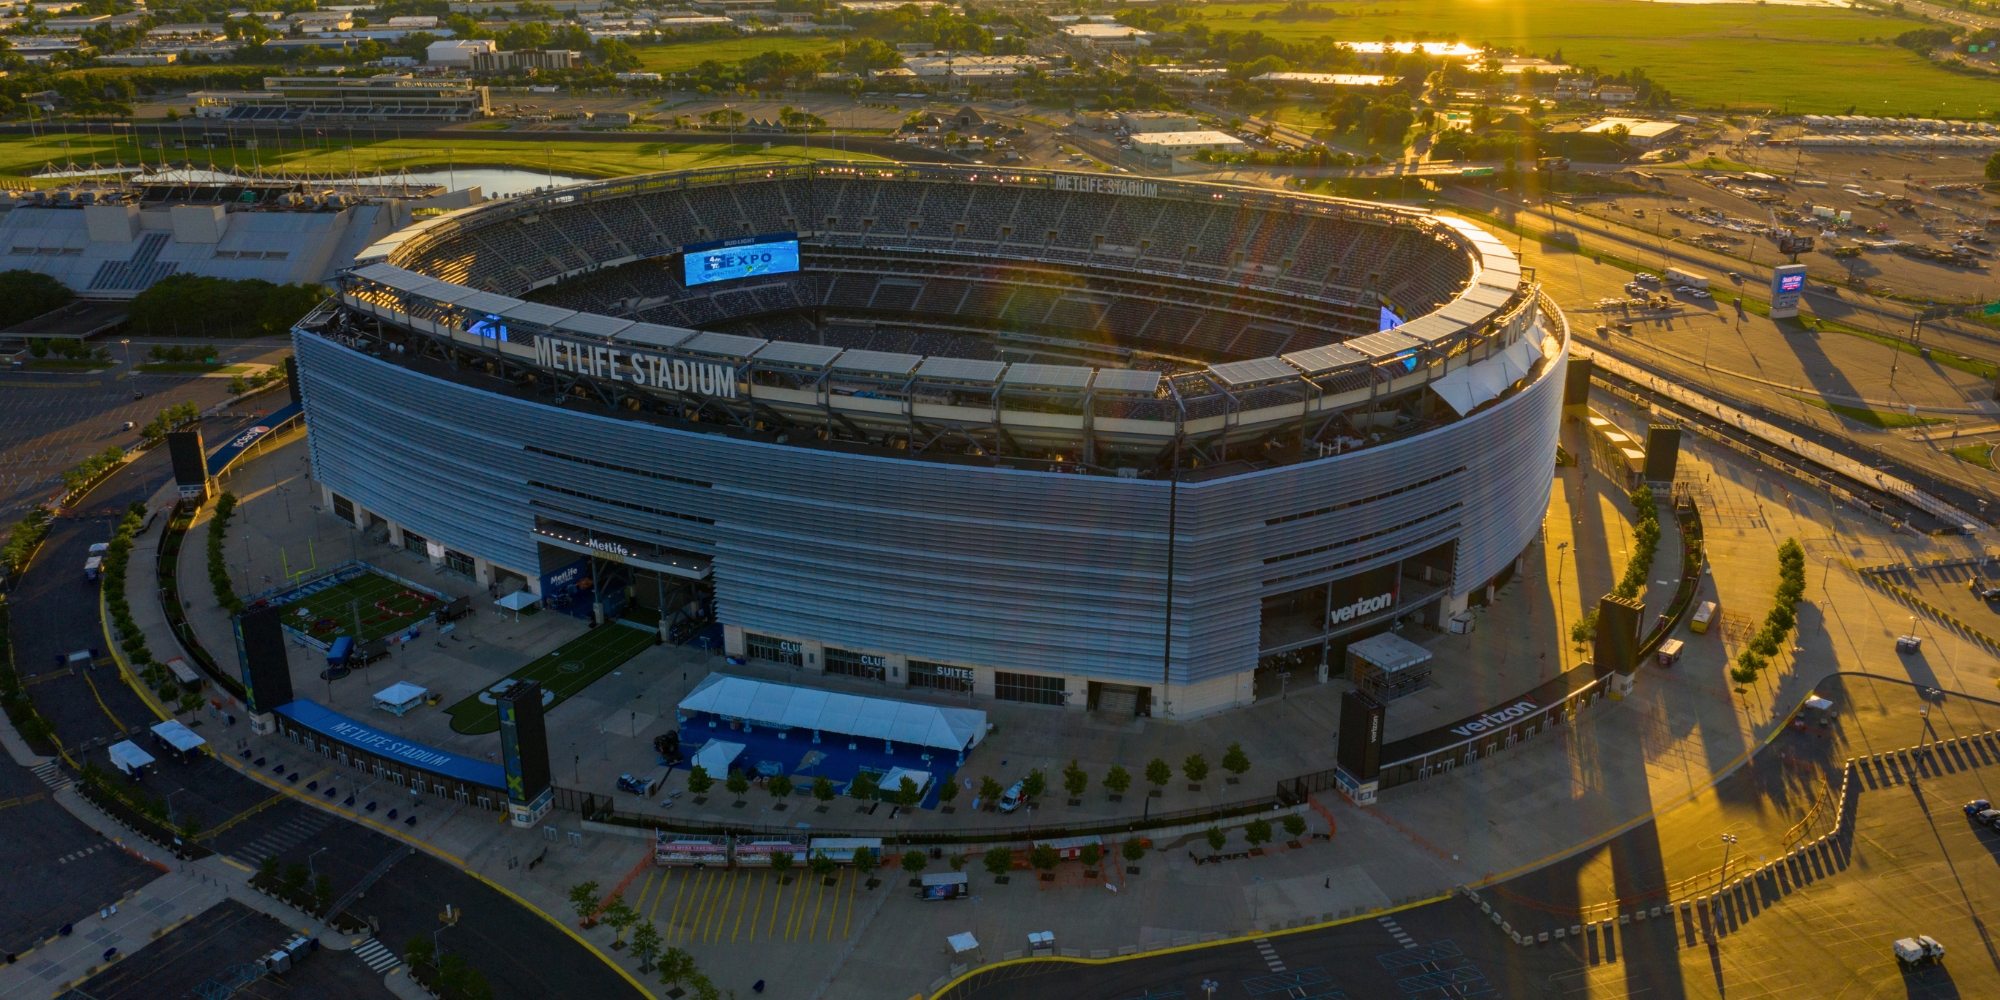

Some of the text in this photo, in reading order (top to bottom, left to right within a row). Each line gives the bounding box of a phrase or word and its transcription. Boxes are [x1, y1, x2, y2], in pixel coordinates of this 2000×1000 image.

[1055, 175, 1158, 198] METLIFE STADIUM
[724, 237, 755, 247] BUD LIGHT
[726, 252, 772, 268] EXPO
[534, 335, 736, 399] METLIFE STADIUM
[232, 431, 258, 448] pepsi
[589, 538, 628, 556] MetLife
[592, 549, 625, 564] CENTRAL
[550, 567, 578, 585] MetLife
[1331, 592, 1392, 624] verizon
[937, 666, 974, 679] SUITES
[1450, 701, 1539, 736] verizon
[1371, 715, 1379, 744] verizon
[330, 722, 451, 767] METLIFE STADIUM
